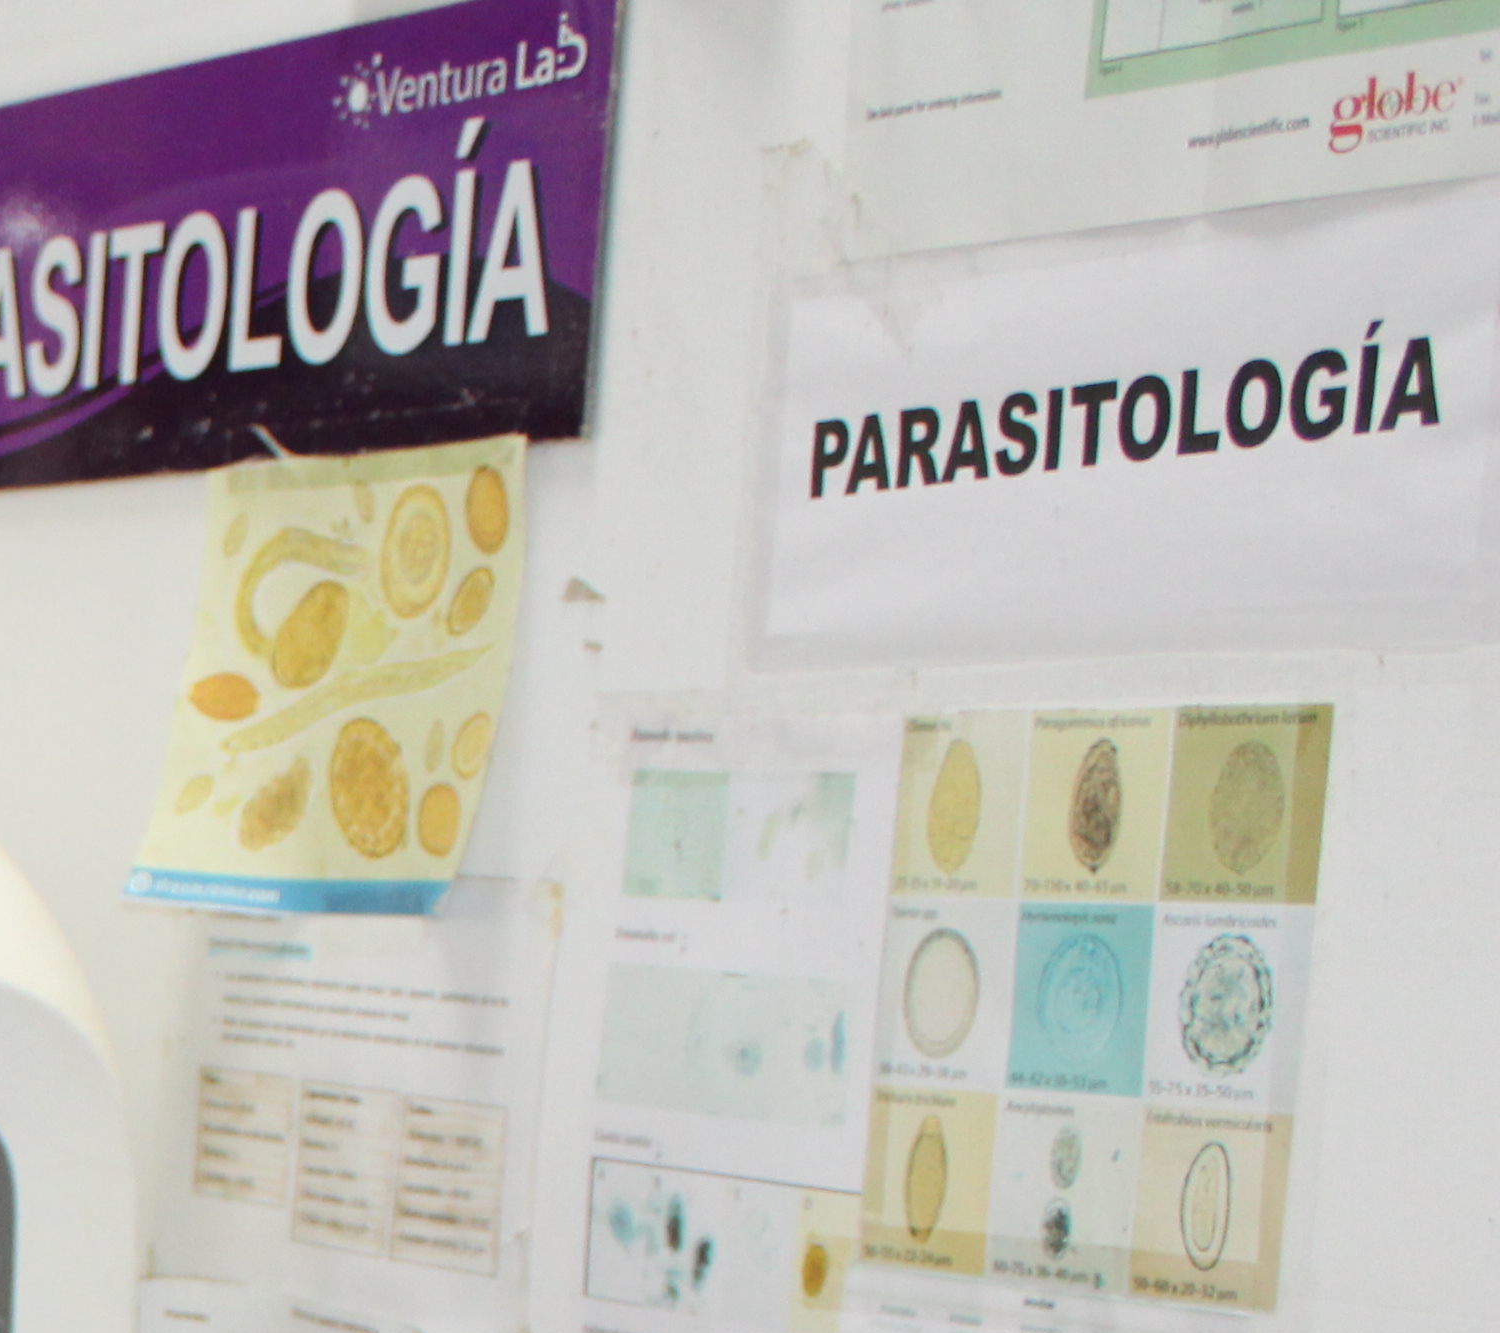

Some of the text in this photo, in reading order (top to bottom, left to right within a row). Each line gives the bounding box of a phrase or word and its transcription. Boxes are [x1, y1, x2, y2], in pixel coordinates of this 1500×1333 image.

[375, 12, 588, 116] Ventura Lab
[1328, 70, 1457, 154] globe
[808, 320, 1441, 499] PARASITOLOGÍA
